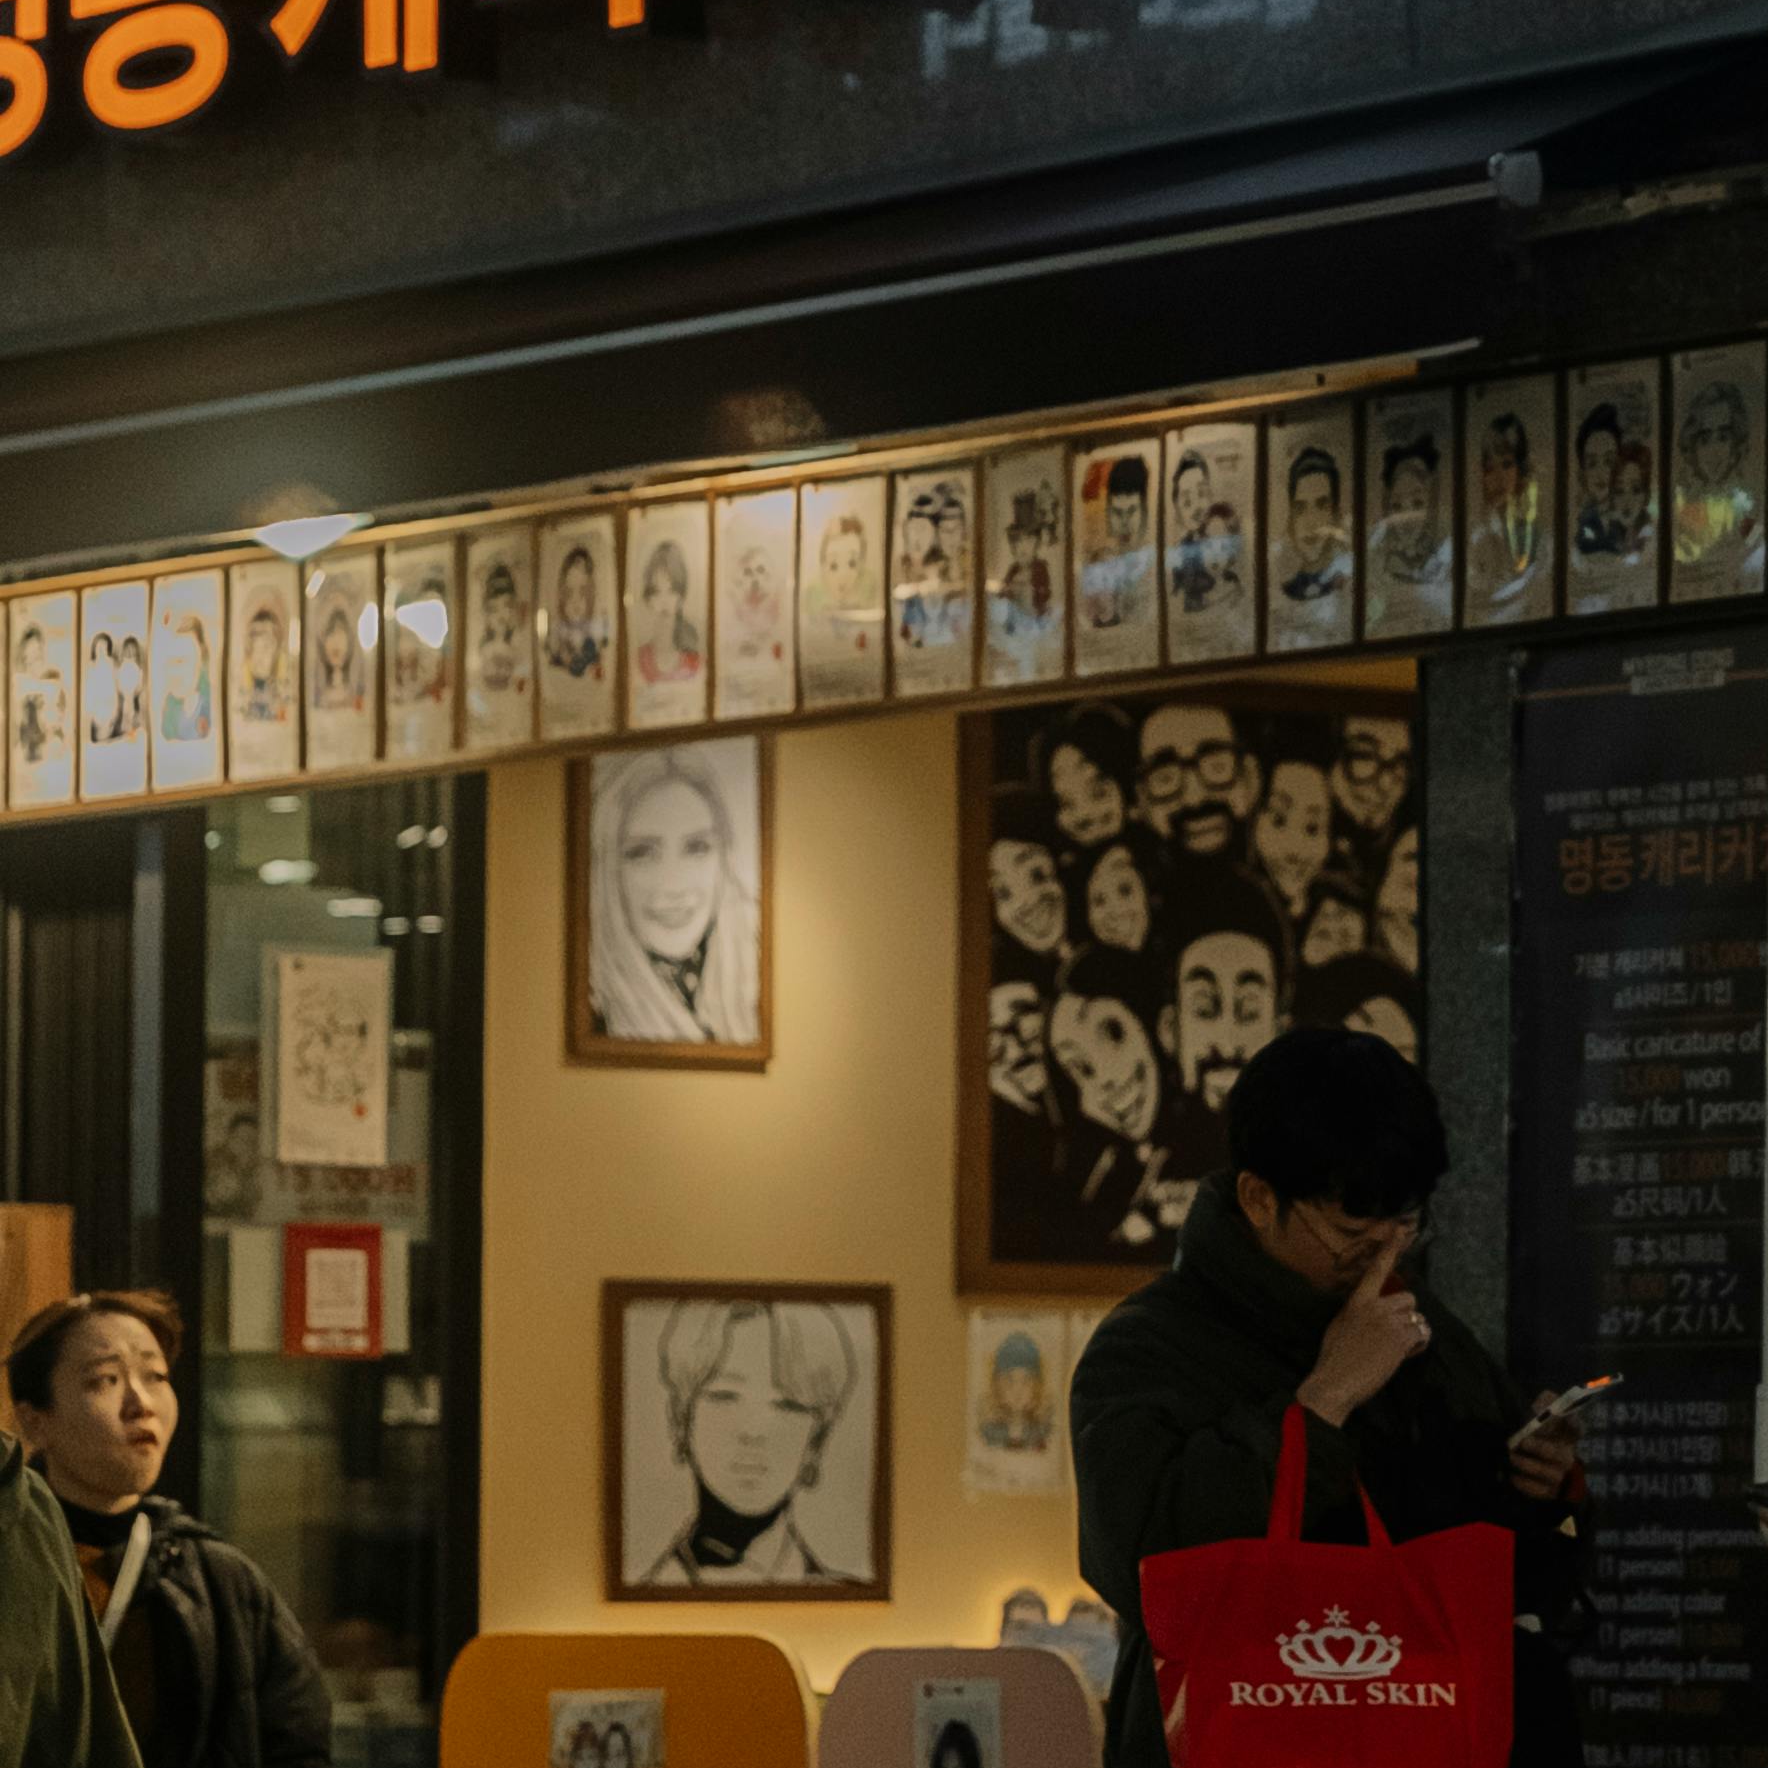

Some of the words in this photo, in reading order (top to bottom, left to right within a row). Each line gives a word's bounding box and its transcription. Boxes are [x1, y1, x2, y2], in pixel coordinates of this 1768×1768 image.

[1634, 1029, 1736, 1058] caricature
[1739, 1021, 1763, 1053] of
[1683, 1066, 1732, 1090] won
[1652, 1095, 1682, 1125] for
[1700, 1100, 1767, 1131] perso
[1228, 1680, 1358, 1709] ROYAL
[1365, 1680, 1457, 1708] SKIN
